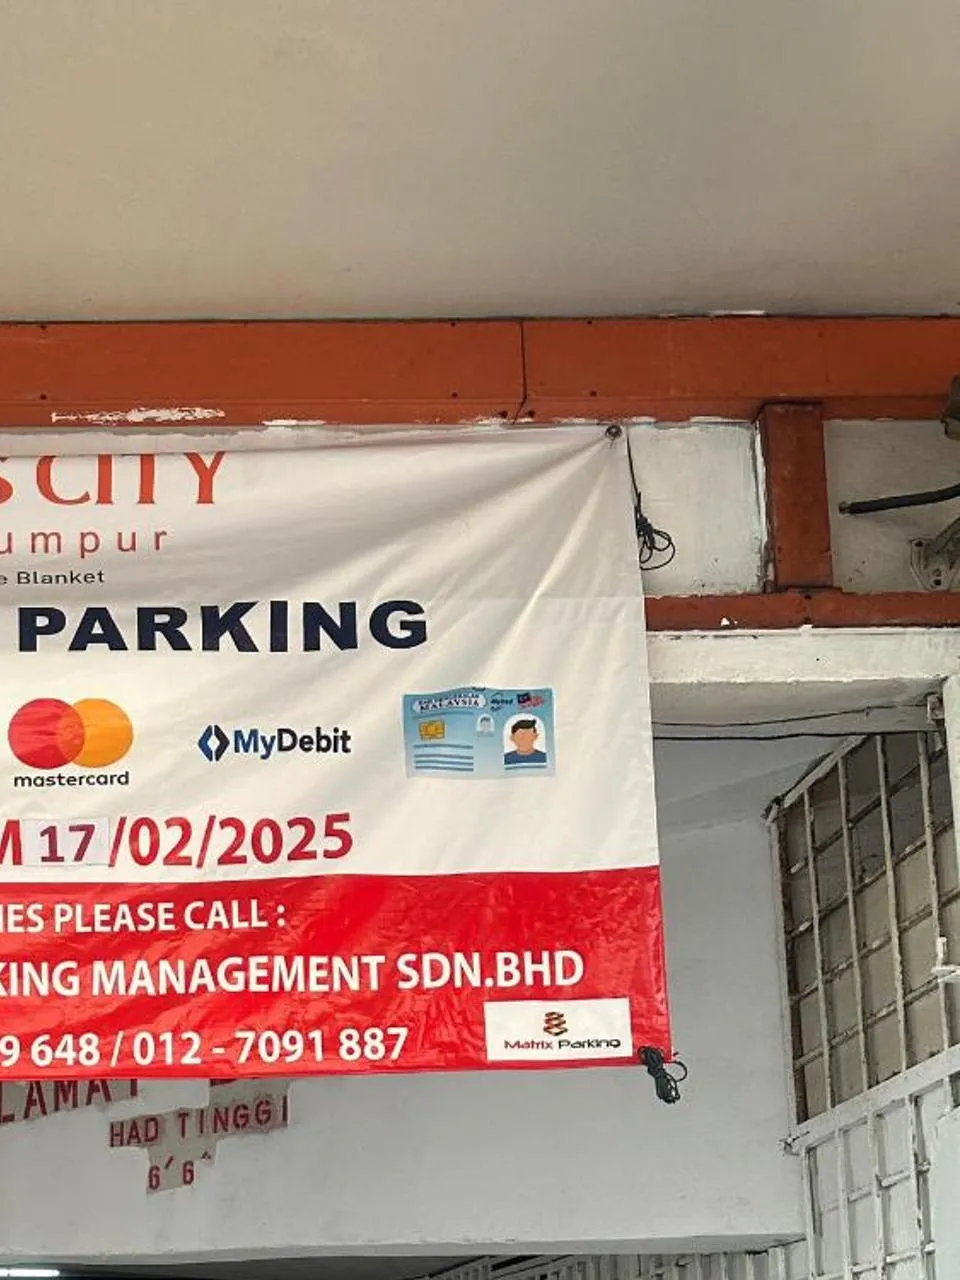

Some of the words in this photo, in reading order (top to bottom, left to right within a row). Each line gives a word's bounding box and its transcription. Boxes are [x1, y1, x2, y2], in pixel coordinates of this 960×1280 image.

[36, 450, 227, 506] CITY
[16, 569, 105, 586] Blanket
[17, 600, 428, 653] PARKING
[233, 726, 352, 759] MyDebit
[13, 770, 130, 788] mastercard
[54, 901, 175, 933] PLEASE
[184, 898, 268, 930] CALL
[91, 955, 386, 996] MANAGEMENT
[396, 949, 586, 991] SDN.BHD
[30, 1033, 100, 1068] 648
[132, 1030, 202, 1067] 012
[235, 1029, 324, 1064] 7091
[339, 1026, 408, 1062] 887
[504, 1037, 553, 1049] Matrix
[109, 1117, 159, 1148] HAD
[178, 1095, 288, 1139] TINGGI
